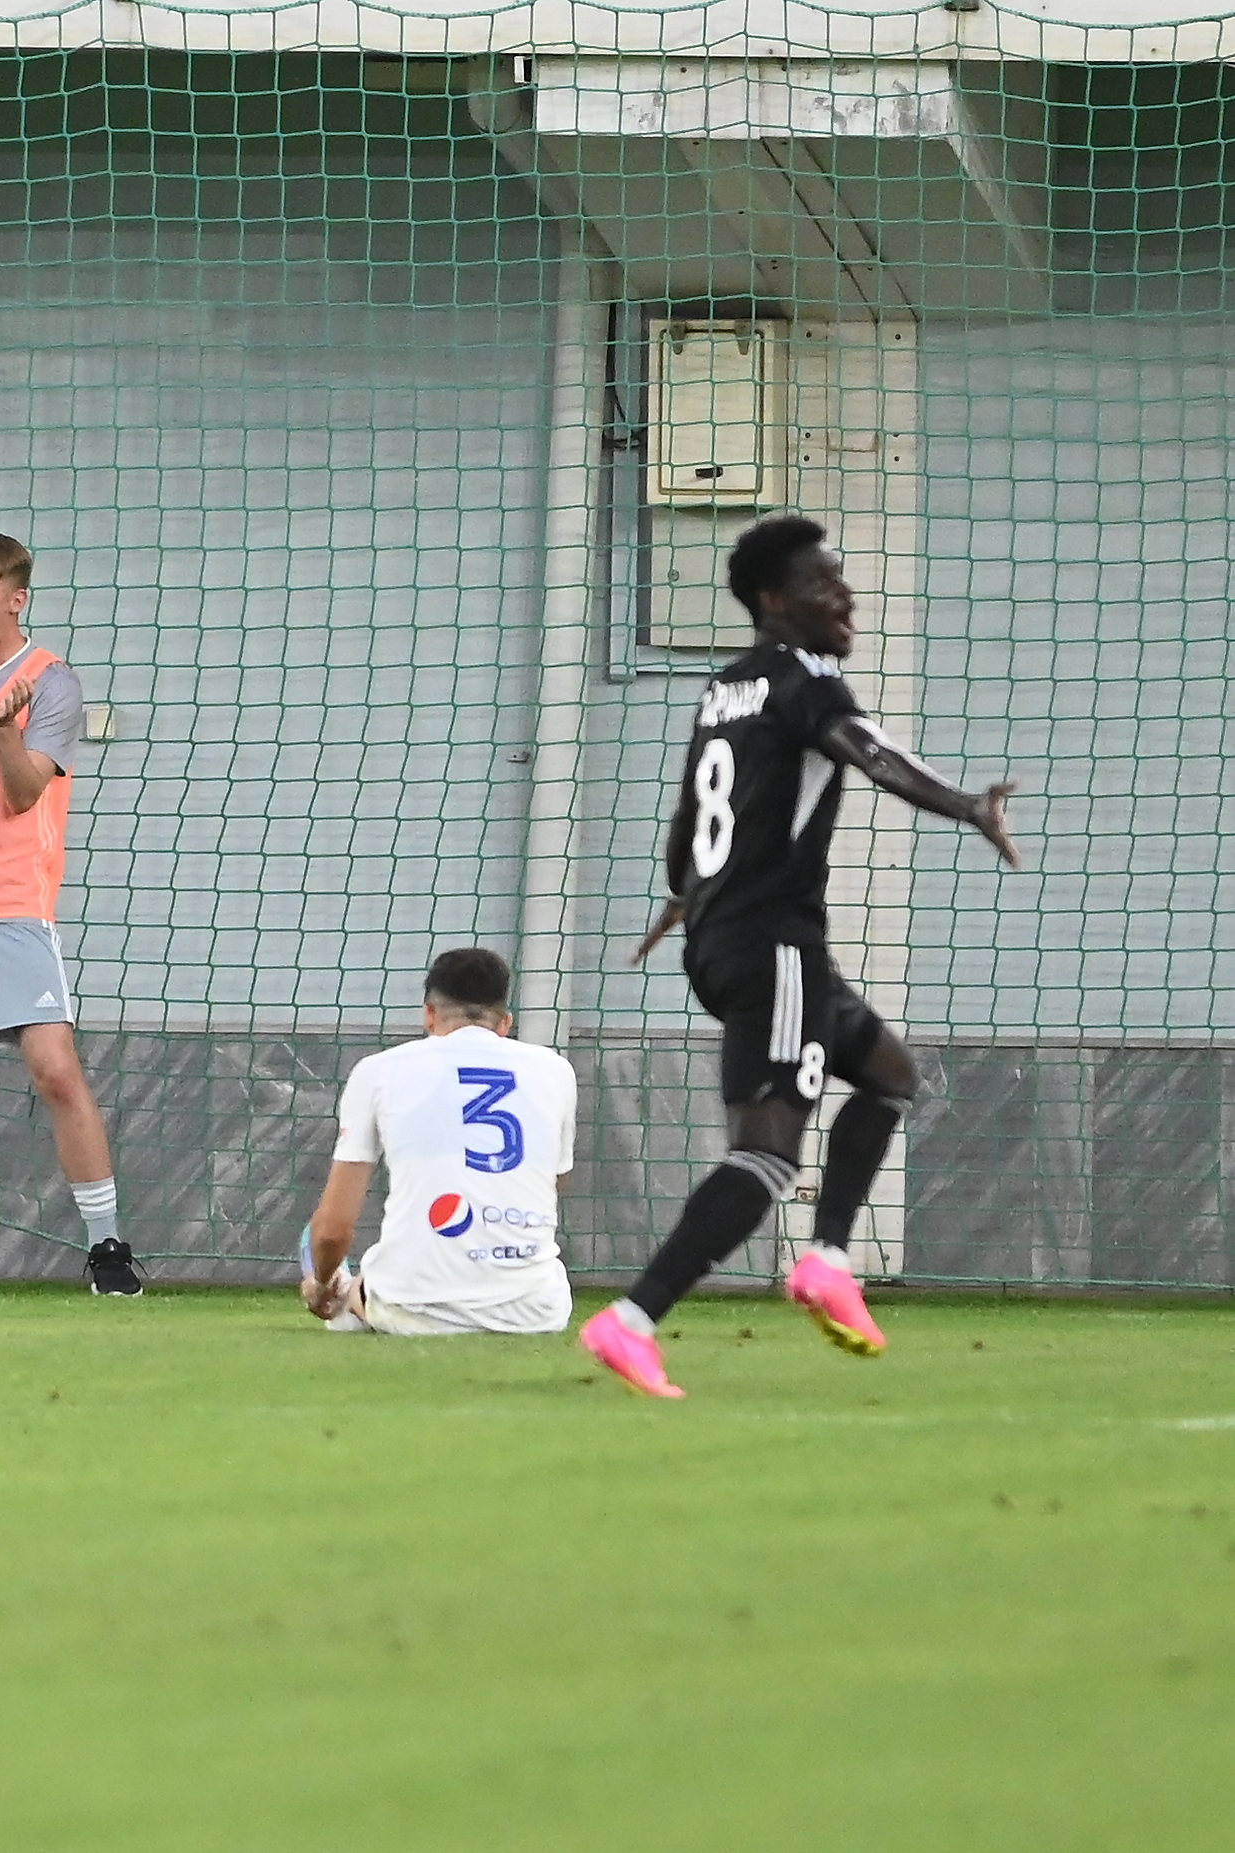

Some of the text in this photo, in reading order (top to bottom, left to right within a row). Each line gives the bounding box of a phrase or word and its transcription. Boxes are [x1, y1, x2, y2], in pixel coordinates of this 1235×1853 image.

[692, 738, 736, 879] 8
[458, 1067, 524, 1174] 3
[796, 1041, 826, 1100] 8
